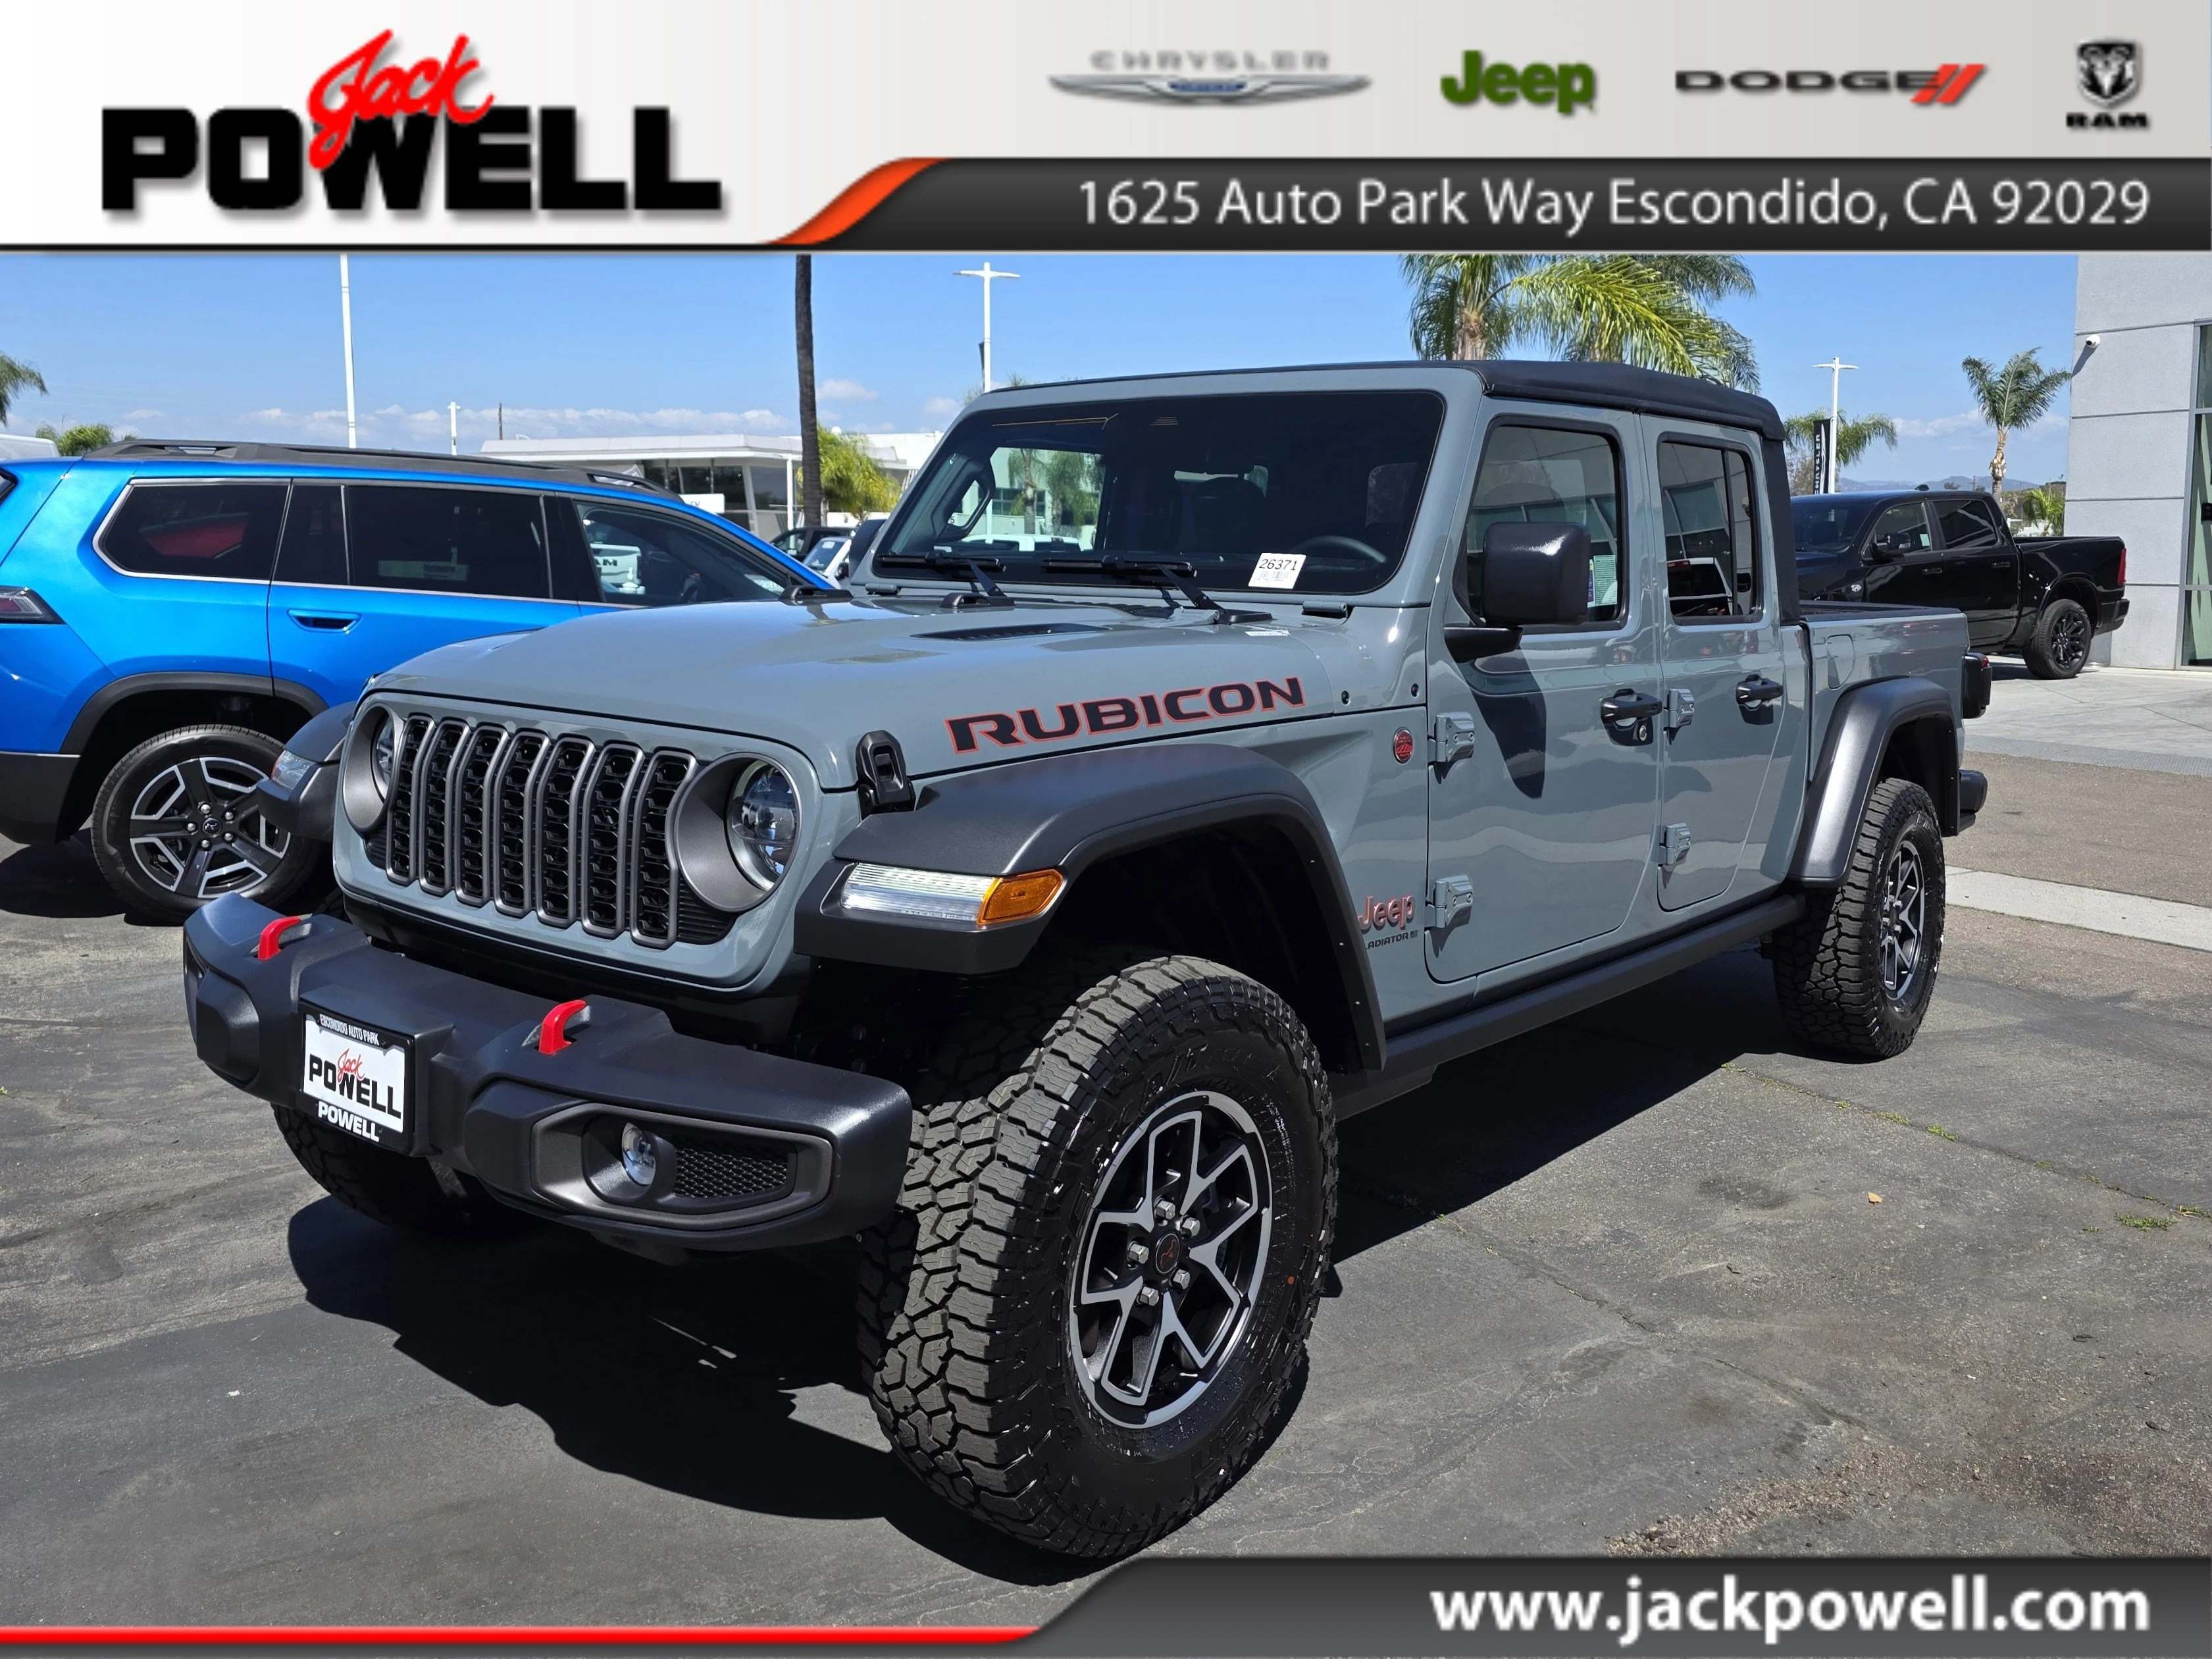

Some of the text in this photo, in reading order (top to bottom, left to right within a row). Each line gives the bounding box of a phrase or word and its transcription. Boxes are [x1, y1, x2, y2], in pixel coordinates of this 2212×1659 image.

[1259, 559, 1297, 571] 26371
[944, 676, 1306, 754] RUBICON
[1357, 895, 1415, 930] Jeep
[1366, 932, 1408, 949] ADIATOR
[319, 1013, 380, 1046] ESCONDIDO AUTO PARK
[337, 1048, 365, 1084] Jack
[309, 1053, 401, 1120] POWELL
[318, 1101, 380, 1142] POWELL
